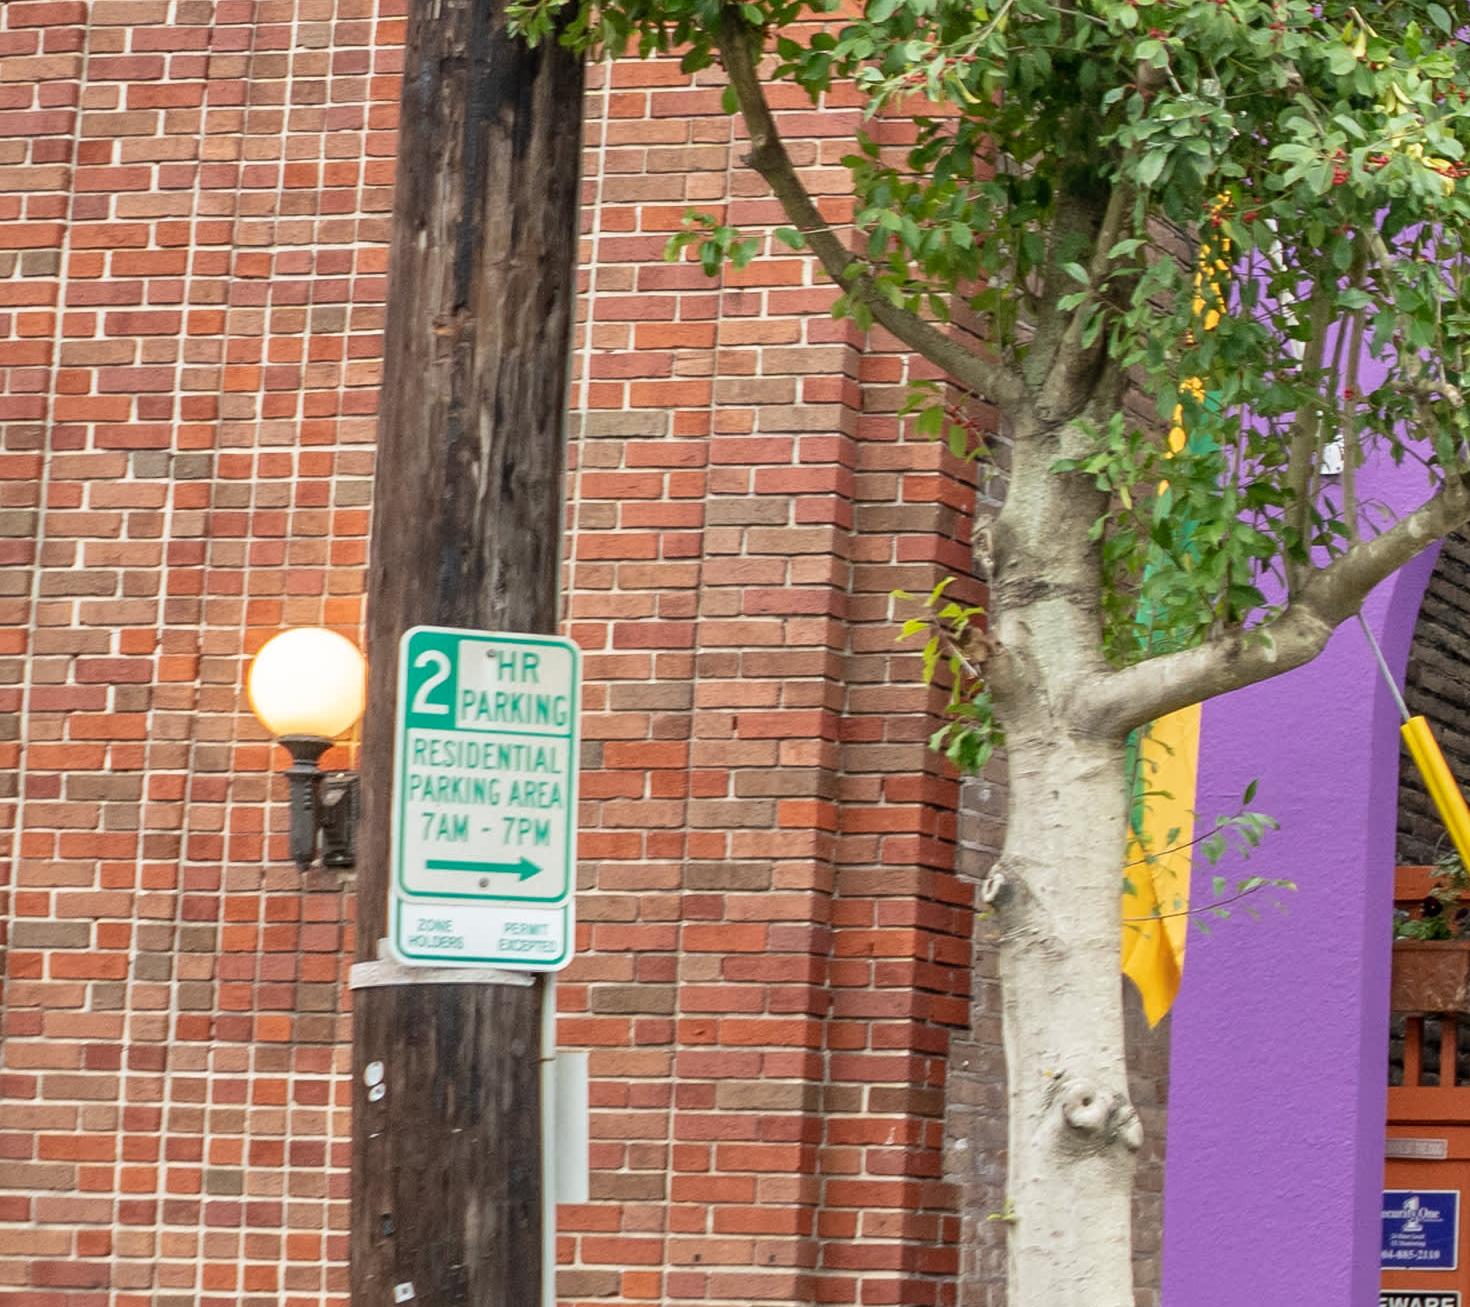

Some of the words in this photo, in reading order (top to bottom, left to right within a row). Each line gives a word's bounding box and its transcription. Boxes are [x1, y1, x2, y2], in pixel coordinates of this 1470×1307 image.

[411, 649, 452, 715] 2
[497, 650, 540, 684] HR
[461, 689, 568, 727] PARKING
[413, 737, 563, 775] RESIDENTIAL
[408, 773, 501, 806] PARKING
[507, 779, 564, 810] AREA
[421, 811, 470, 842] 7AM
[503, 816, 551, 847] 7PM
[408, 934, 465, 950] HOLDERS
[497, 938, 558, 953] EXCEPTED
[416, 917, 454, 933] ZONE
[504, 921, 549, 936] PERMIT
[1381, 1209, 1417, 1225] ecurity
